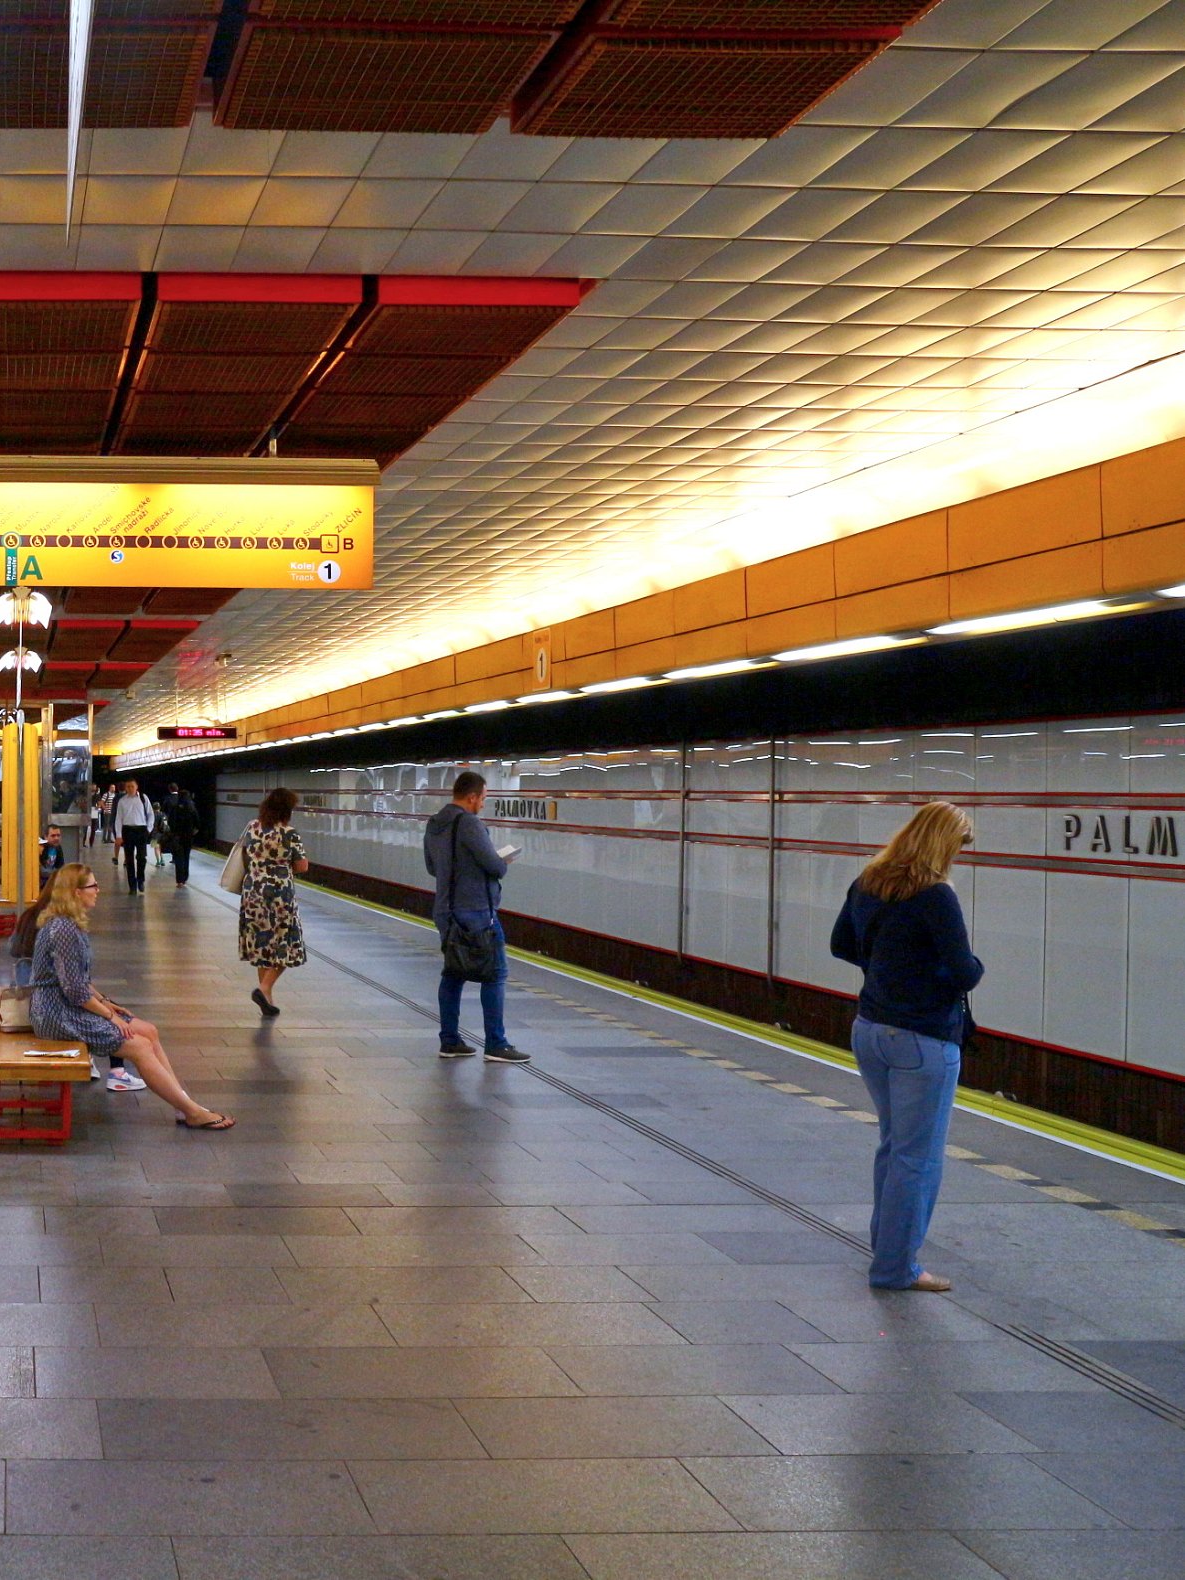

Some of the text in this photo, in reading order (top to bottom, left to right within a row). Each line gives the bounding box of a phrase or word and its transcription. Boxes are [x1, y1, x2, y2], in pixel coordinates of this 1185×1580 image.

[343, 538, 354, 550] B
[20, 555, 43, 580] A
[290, 562, 315, 573] Kolej
[324, 563, 332, 579] 1
[539, 653, 544, 678] 1
[495, 800, 547, 820] PALMOVKA
[1062, 813, 1179, 857] PALM
